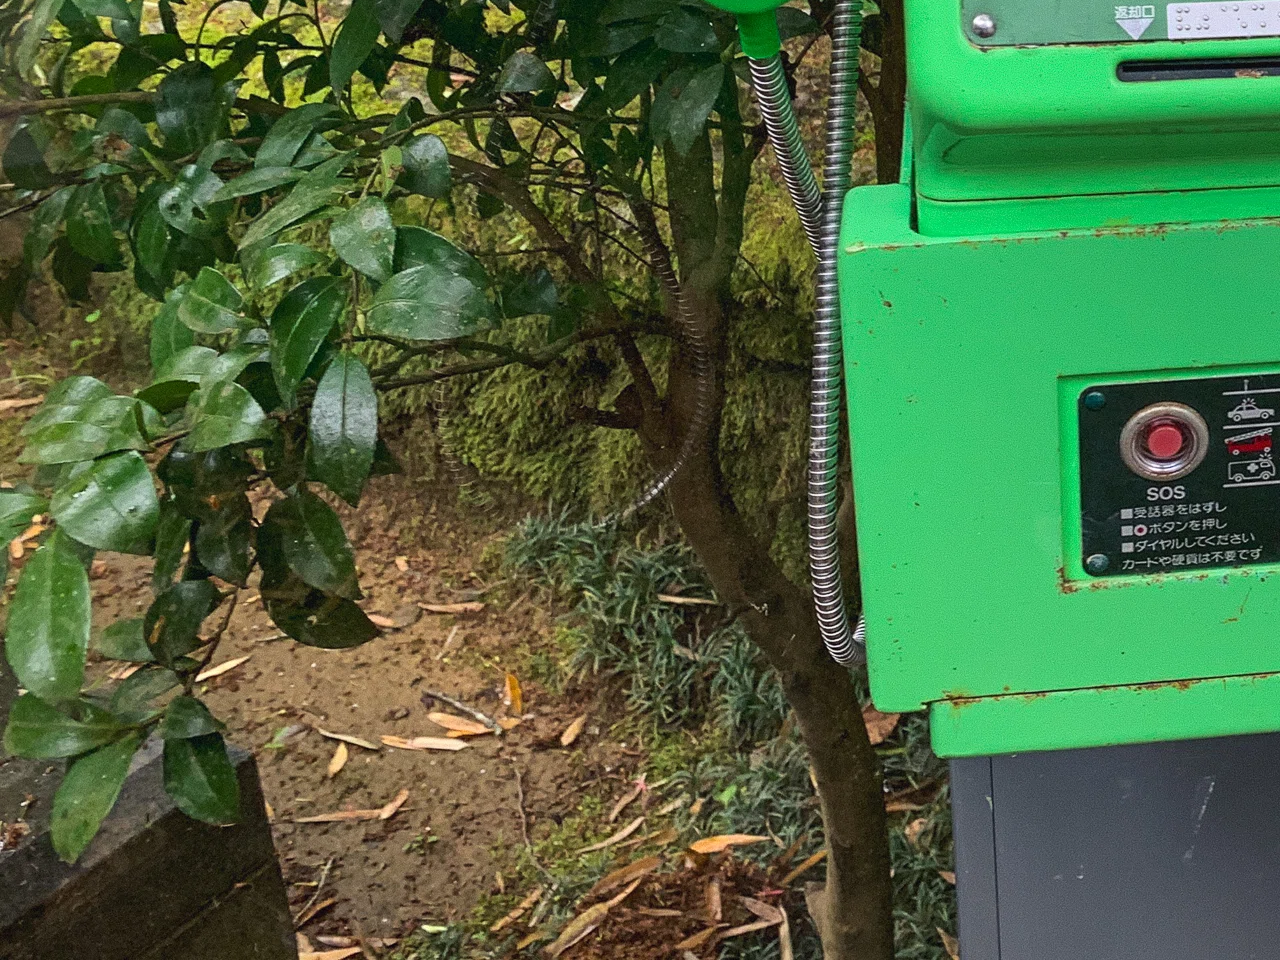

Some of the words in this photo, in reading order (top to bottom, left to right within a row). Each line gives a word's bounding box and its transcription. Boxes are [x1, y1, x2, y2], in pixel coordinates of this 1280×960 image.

[1114, 5, 1155, 19] 返却口
[1146, 485, 1186, 501] SOS
[1133, 501, 1228, 520] 受話器をはずし
[1149, 518, 1228, 535] ボタンを押し
[1135, 532, 1256, 553] ダイヤルしてください
[1121, 545, 1264, 571] カードや硬貨は不要です
